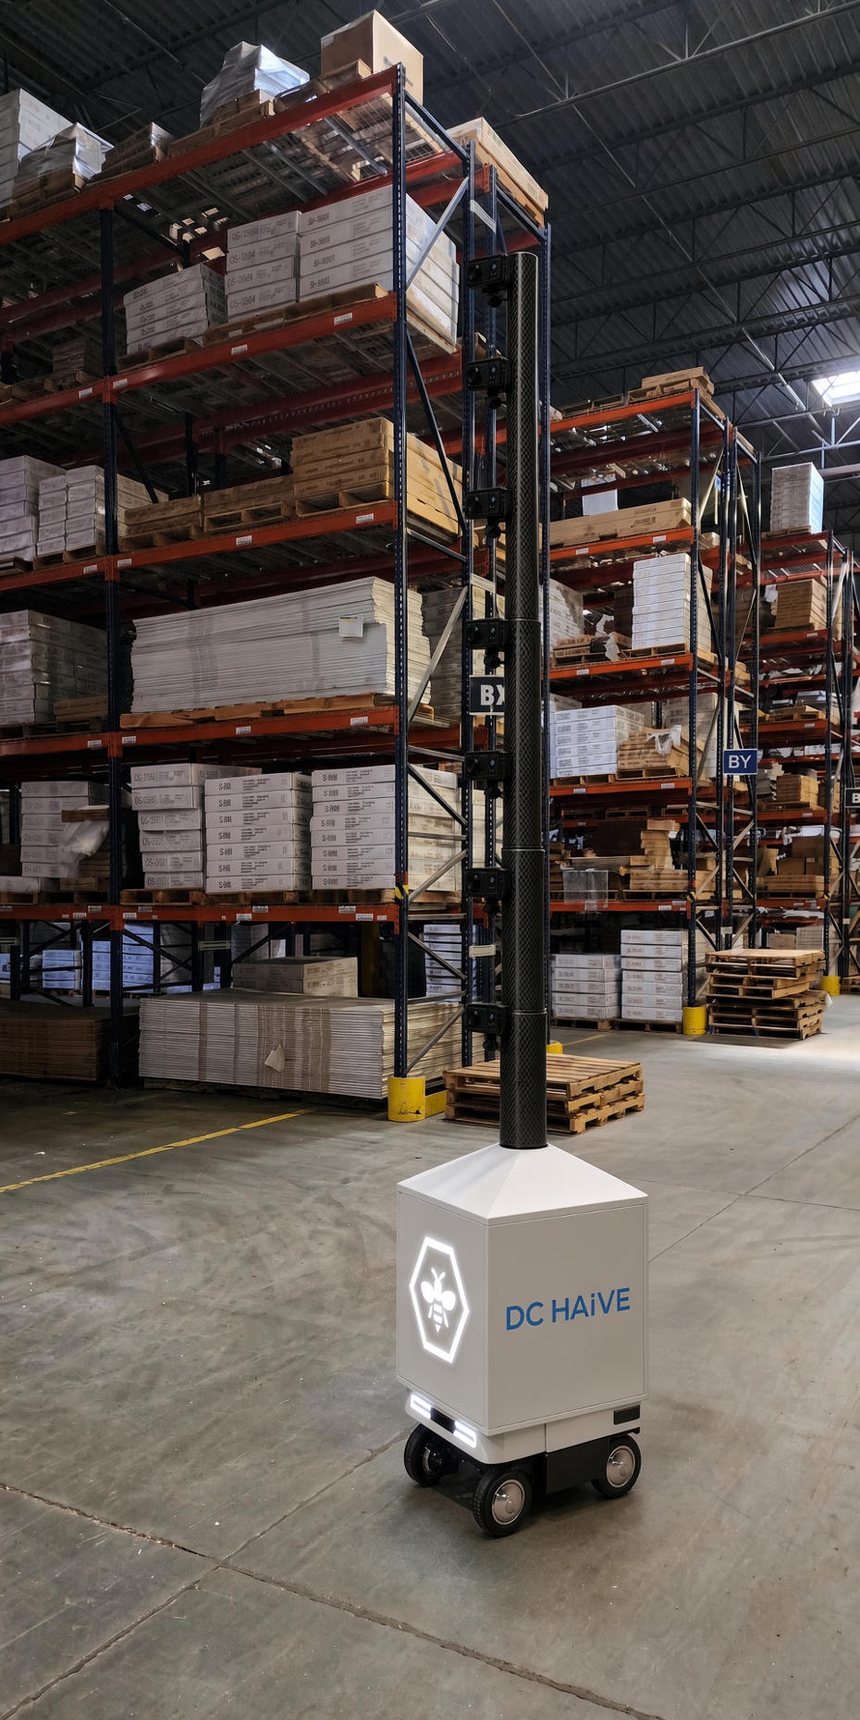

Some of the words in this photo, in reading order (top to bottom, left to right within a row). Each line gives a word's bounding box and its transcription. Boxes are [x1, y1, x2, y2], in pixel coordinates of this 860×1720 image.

[728, 755, 751, 769] BY
[506, 1301, 544, 1330] DC
[551, 1287, 631, 1323] HAiVE
